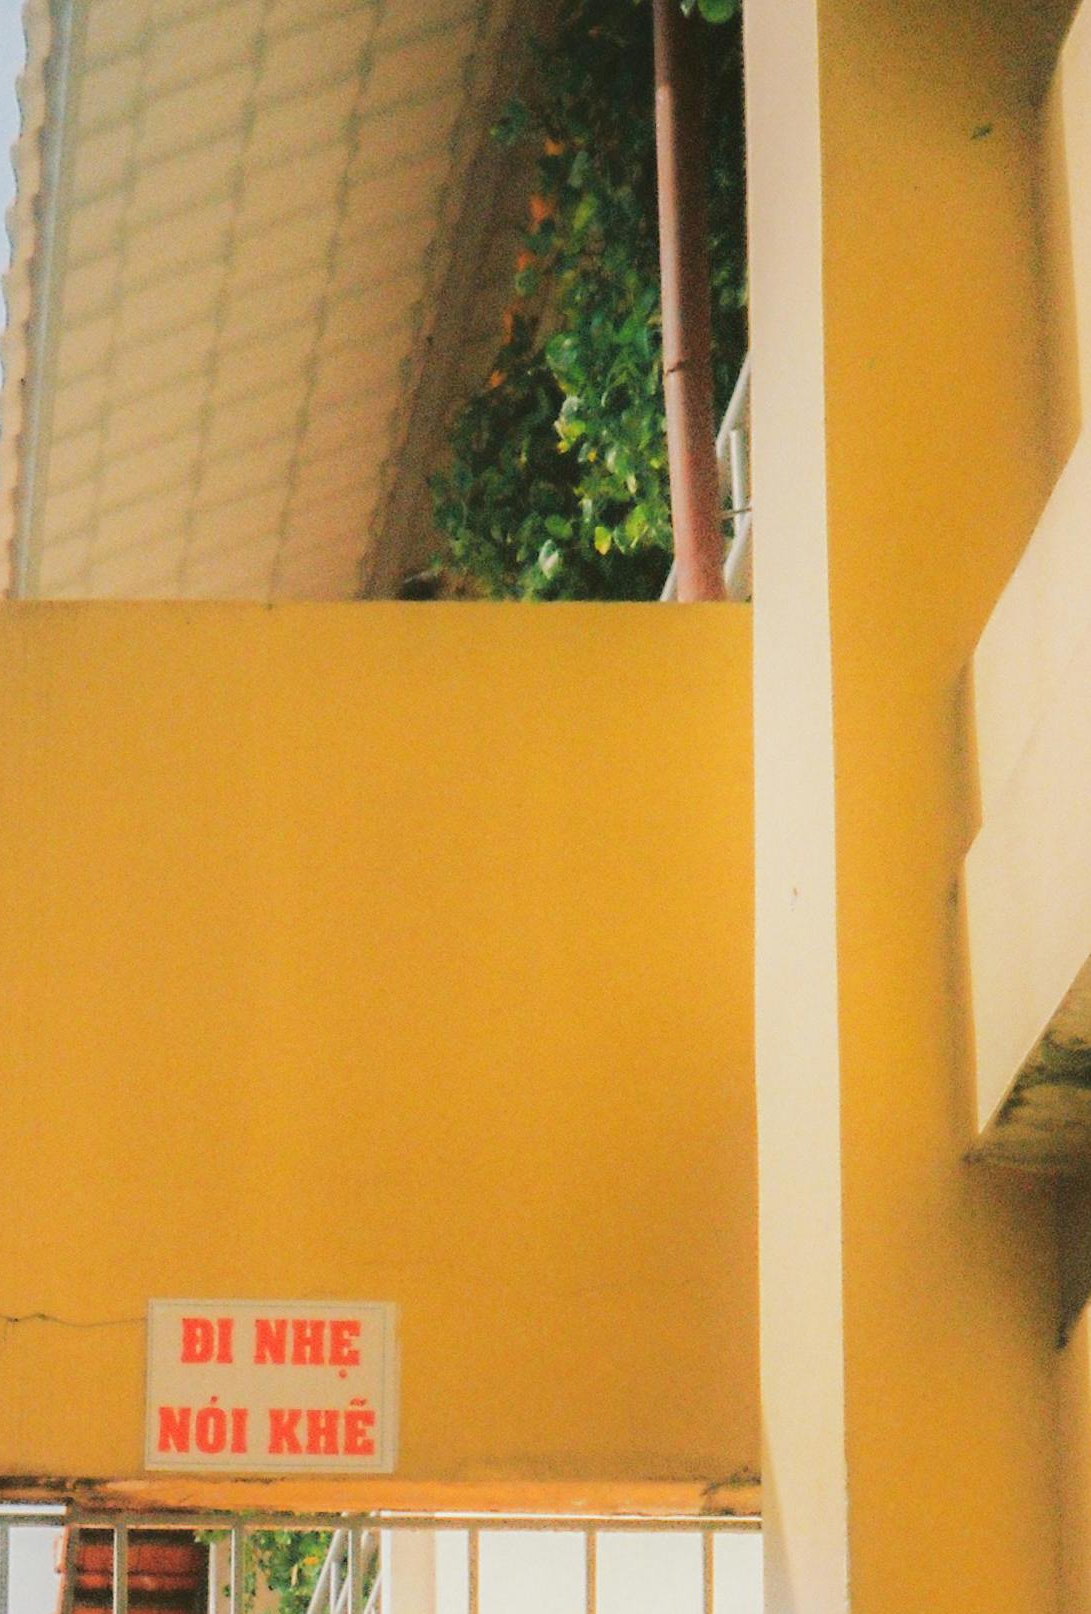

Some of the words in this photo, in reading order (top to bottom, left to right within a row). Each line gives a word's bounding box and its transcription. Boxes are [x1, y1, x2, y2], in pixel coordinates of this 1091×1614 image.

[180, 1317, 234, 1365] ĐI
[252, 1318, 362, 1379] NHẸ
[157, 1396, 250, 1455] NÓI
[267, 1397, 376, 1456] KHẼ
